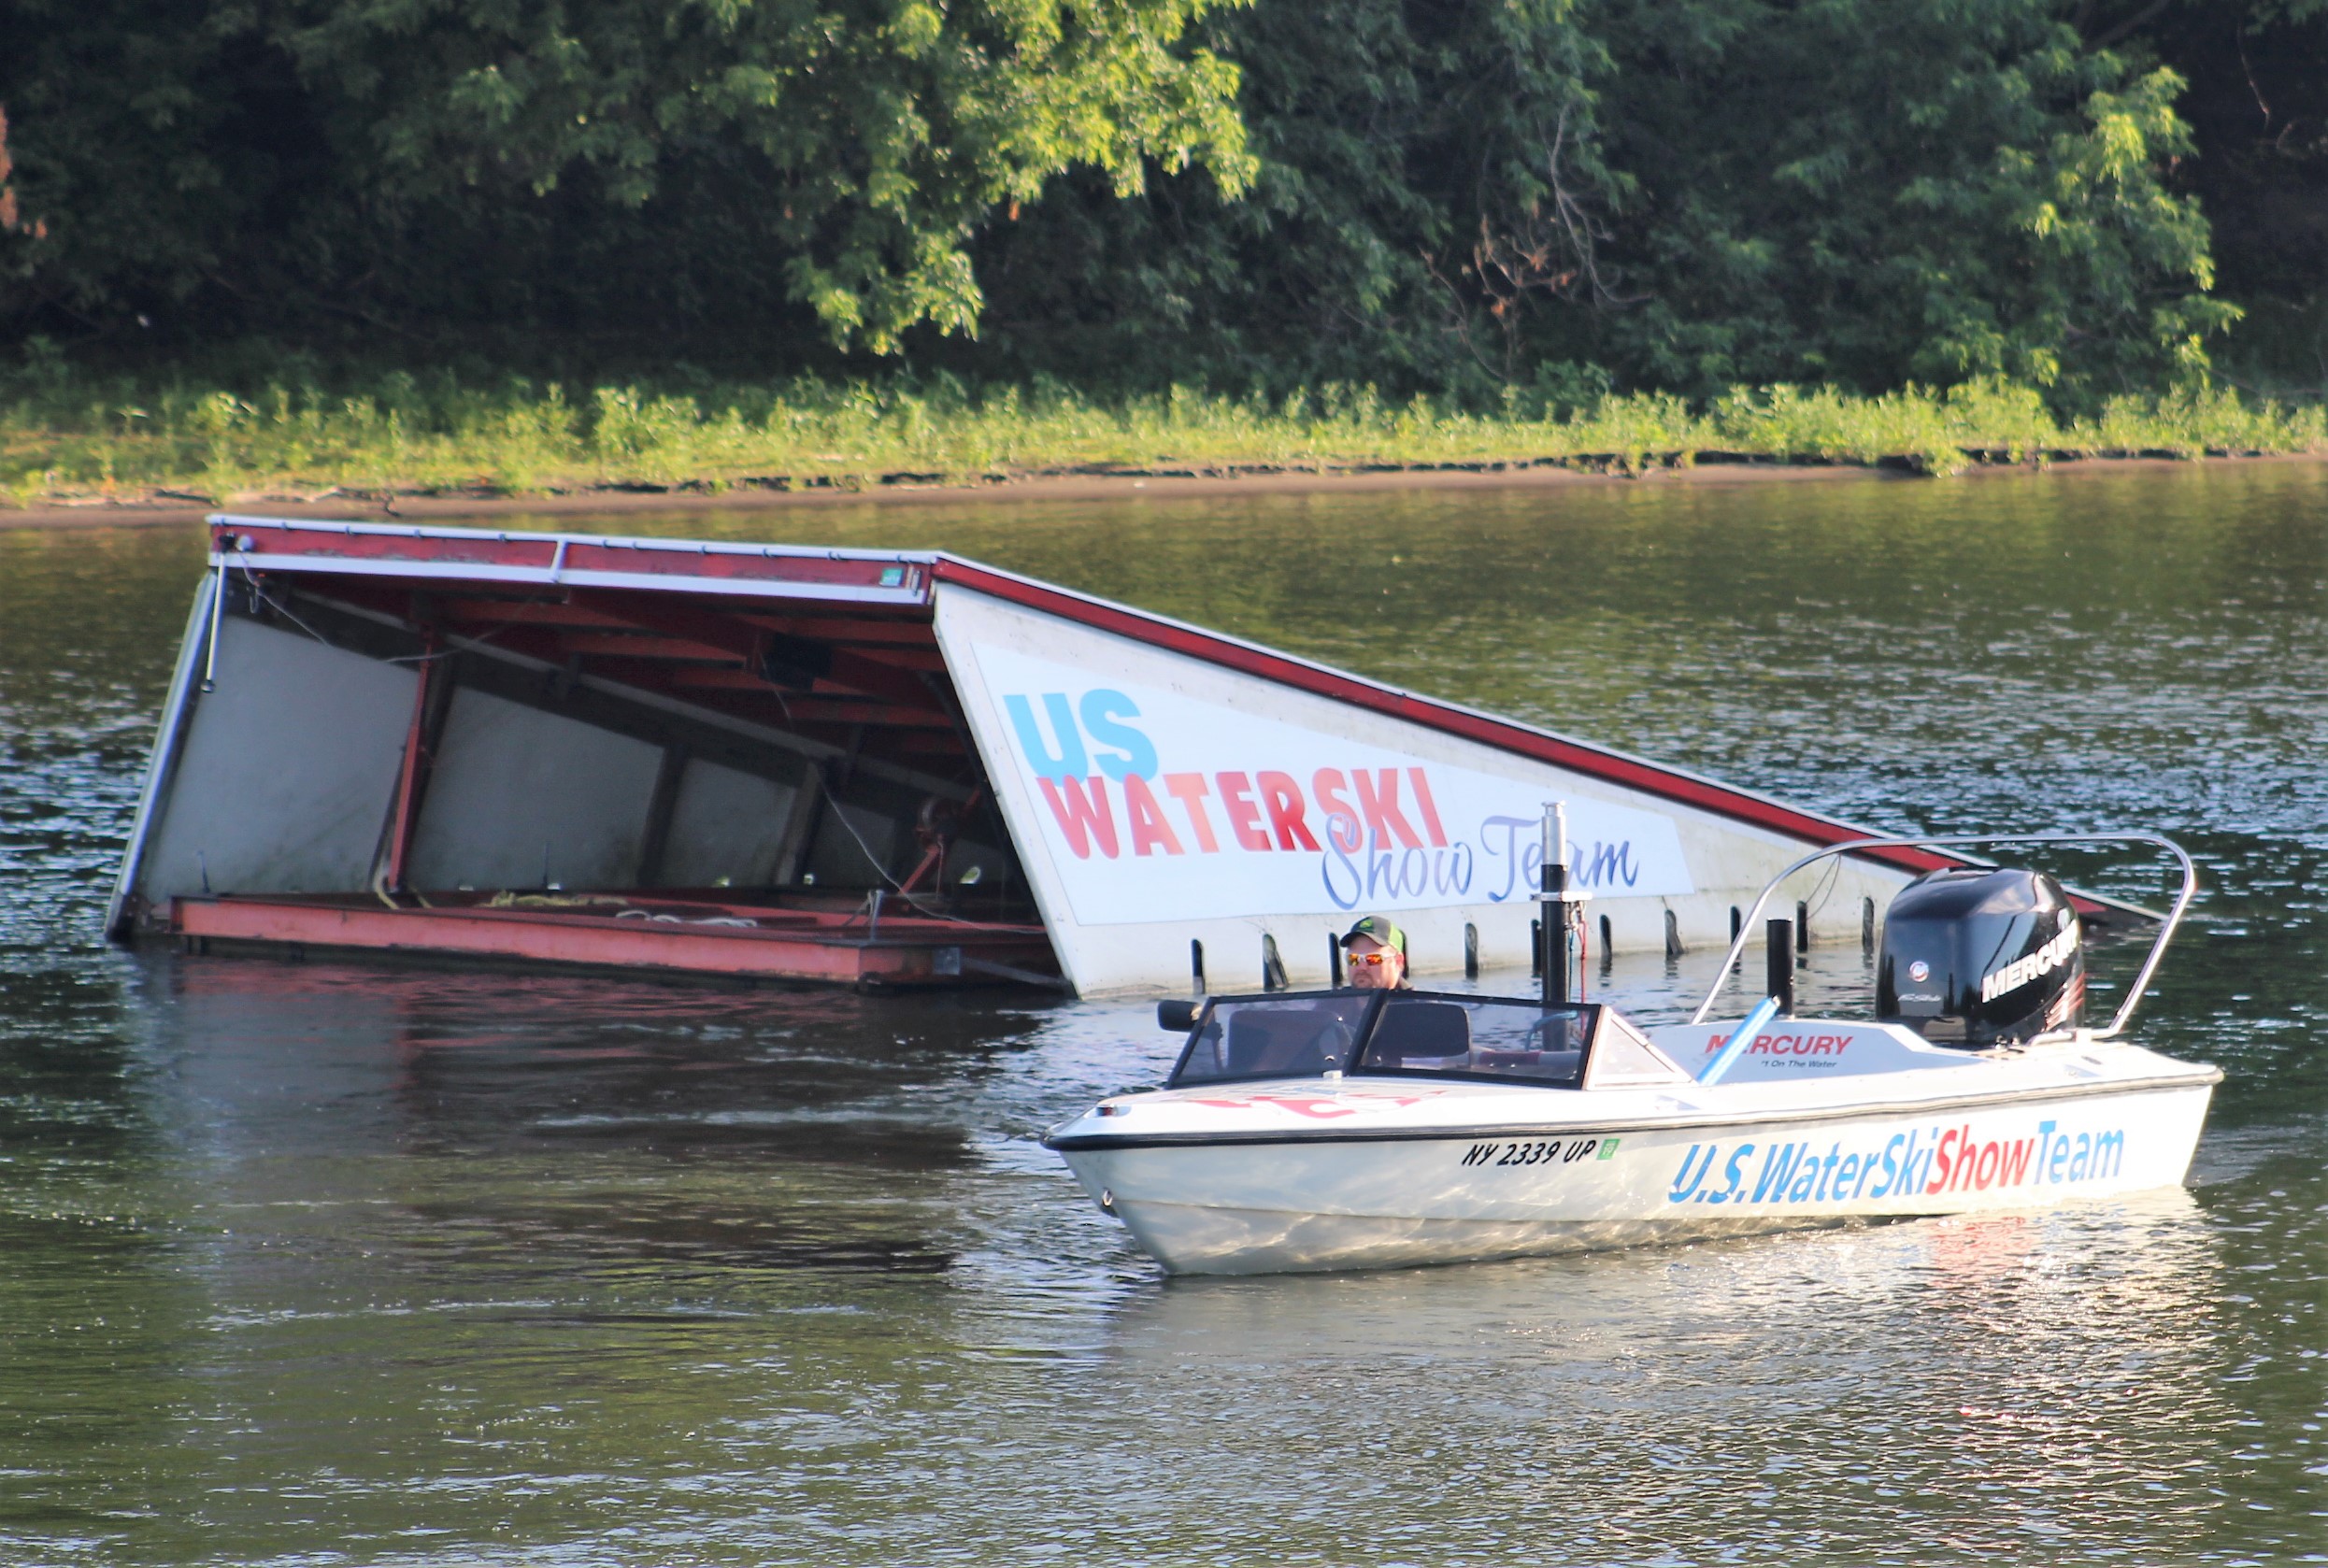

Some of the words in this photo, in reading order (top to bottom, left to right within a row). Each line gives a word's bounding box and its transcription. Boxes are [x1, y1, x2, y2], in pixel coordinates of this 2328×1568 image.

[1003, 688, 1159, 788] US
[1035, 766, 1449, 861] WATERSKI
[1321, 812, 1474, 911] Show
[1480, 815, 1639, 903] Team
[1705, 1034, 1853, 1055] MRCURY
[1788, 1060, 1806, 1068] The
[1808, 1060, 1837, 1068] Water
[1461, 1143, 1499, 1167] NY
[1496, 1140, 1562, 1166] 2339
[1563, 1139, 1597, 1163] UP
